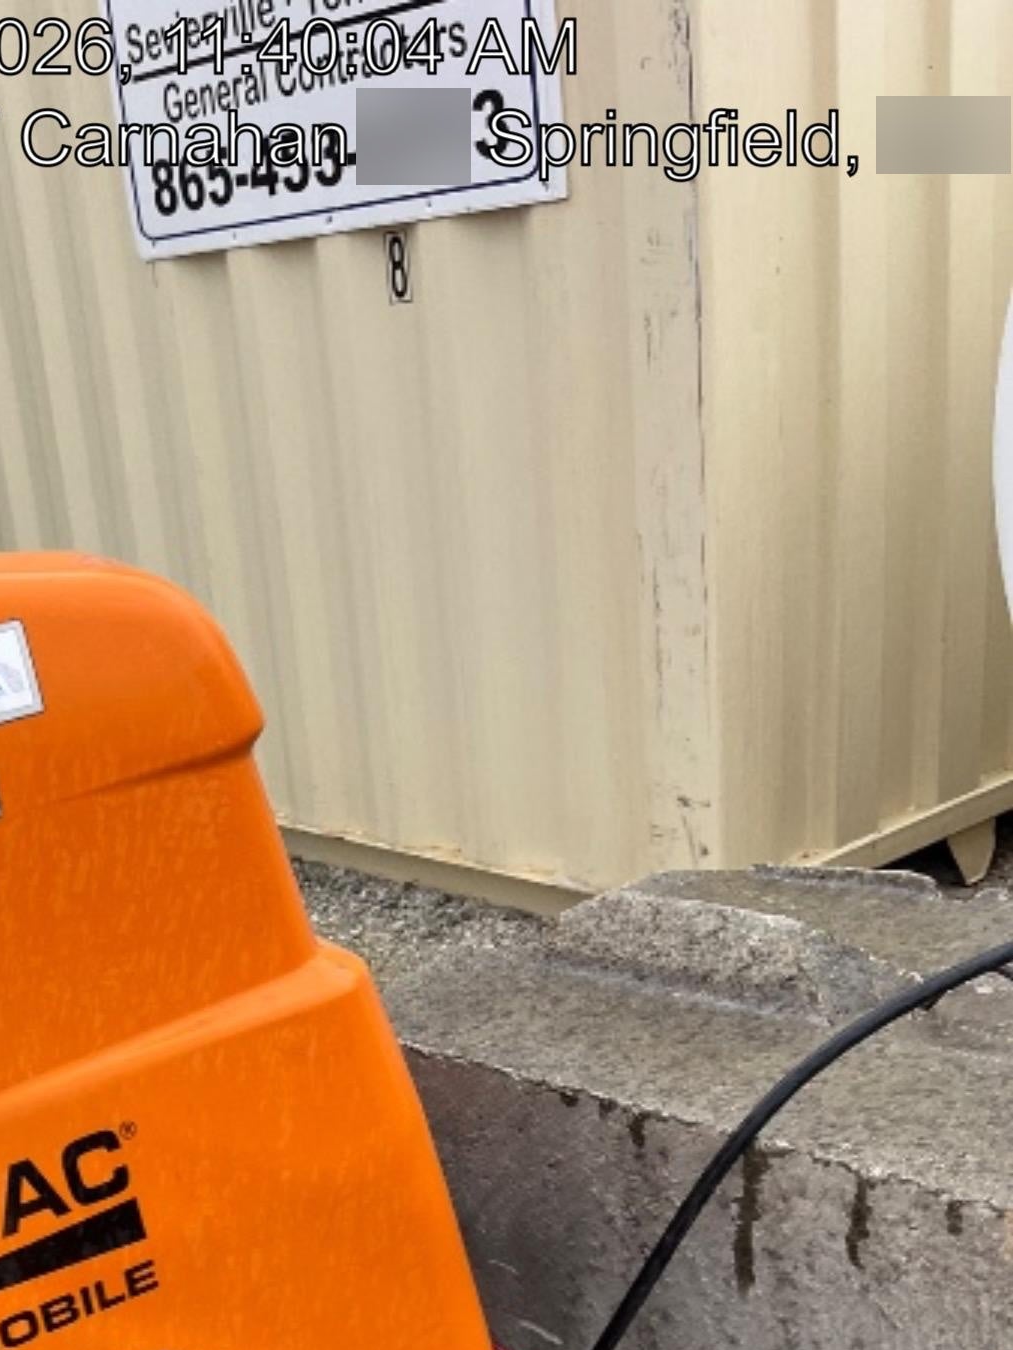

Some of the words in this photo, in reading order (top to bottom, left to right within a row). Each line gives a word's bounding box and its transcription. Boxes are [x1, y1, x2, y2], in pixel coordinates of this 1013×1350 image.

[126, 0, 275, 64] Severville
[163, 60, 268, 123] General
[275, 21, 468, 97] Contrctrs
